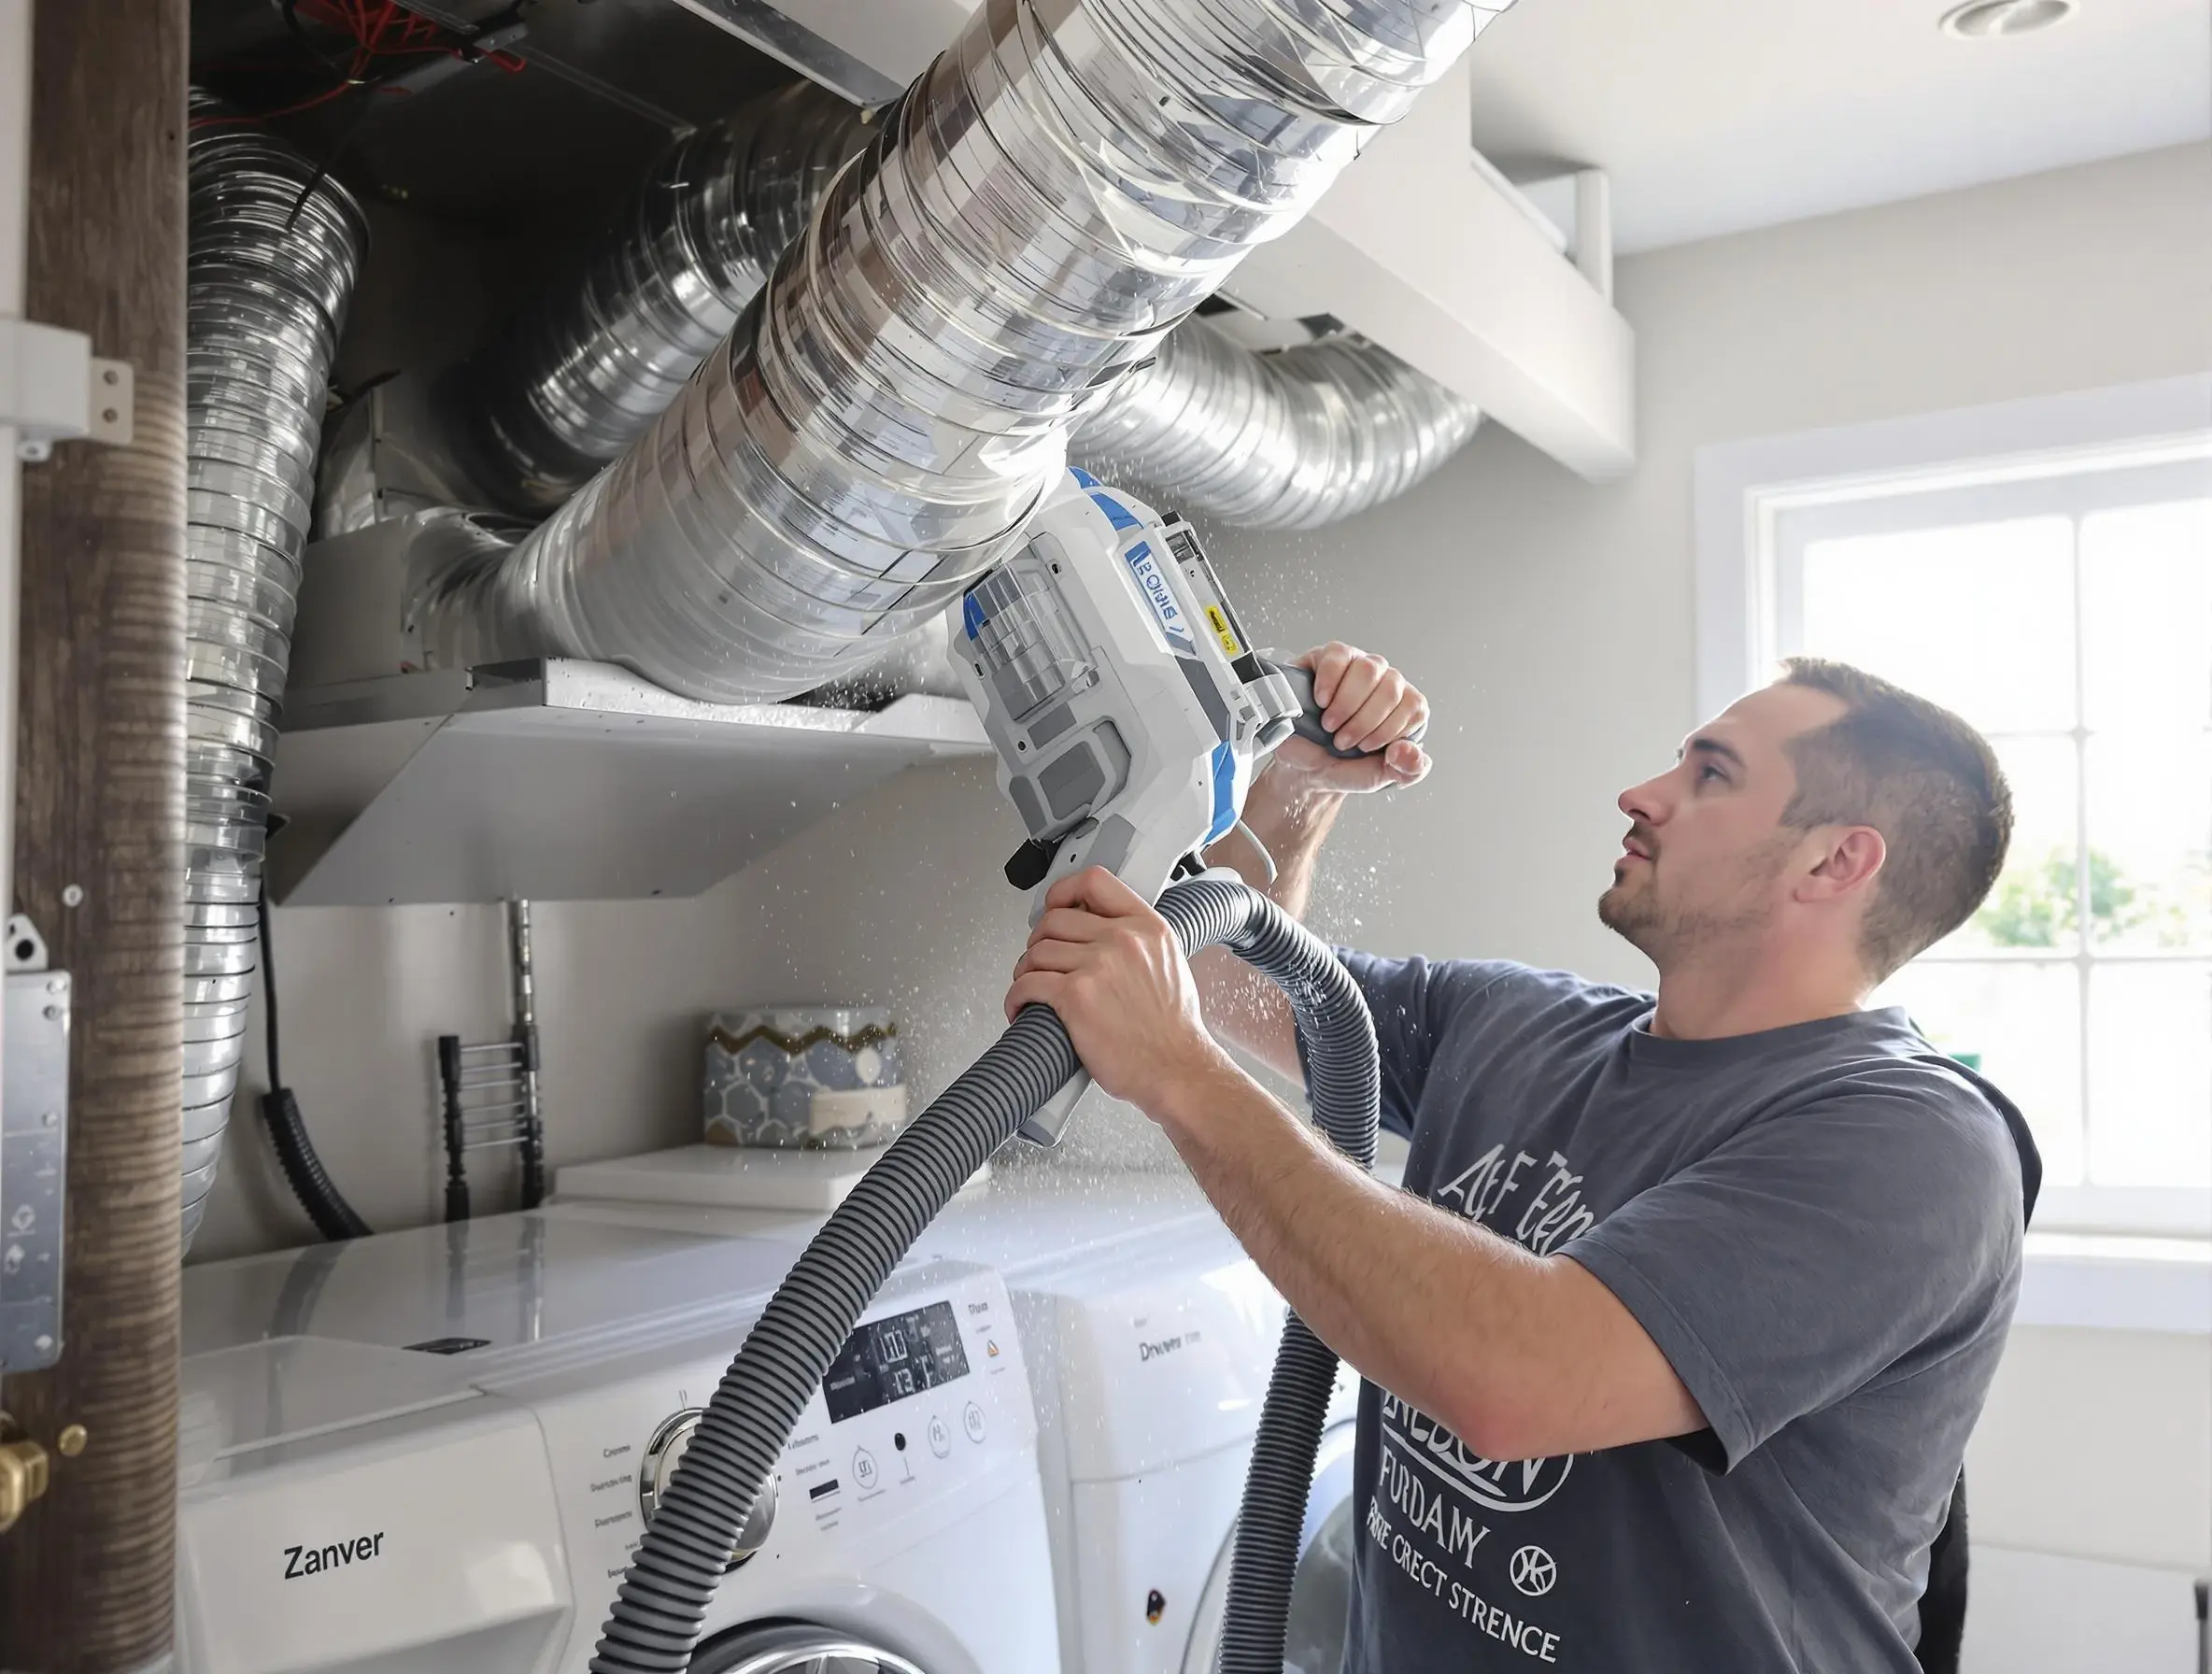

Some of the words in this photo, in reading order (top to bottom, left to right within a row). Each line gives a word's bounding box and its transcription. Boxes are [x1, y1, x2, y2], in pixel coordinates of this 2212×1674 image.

[284, 1531, 384, 1580] Zanver
[1392, 1534, 1448, 1597] CRECT
[1449, 1582, 1561, 1664] STRENCE
